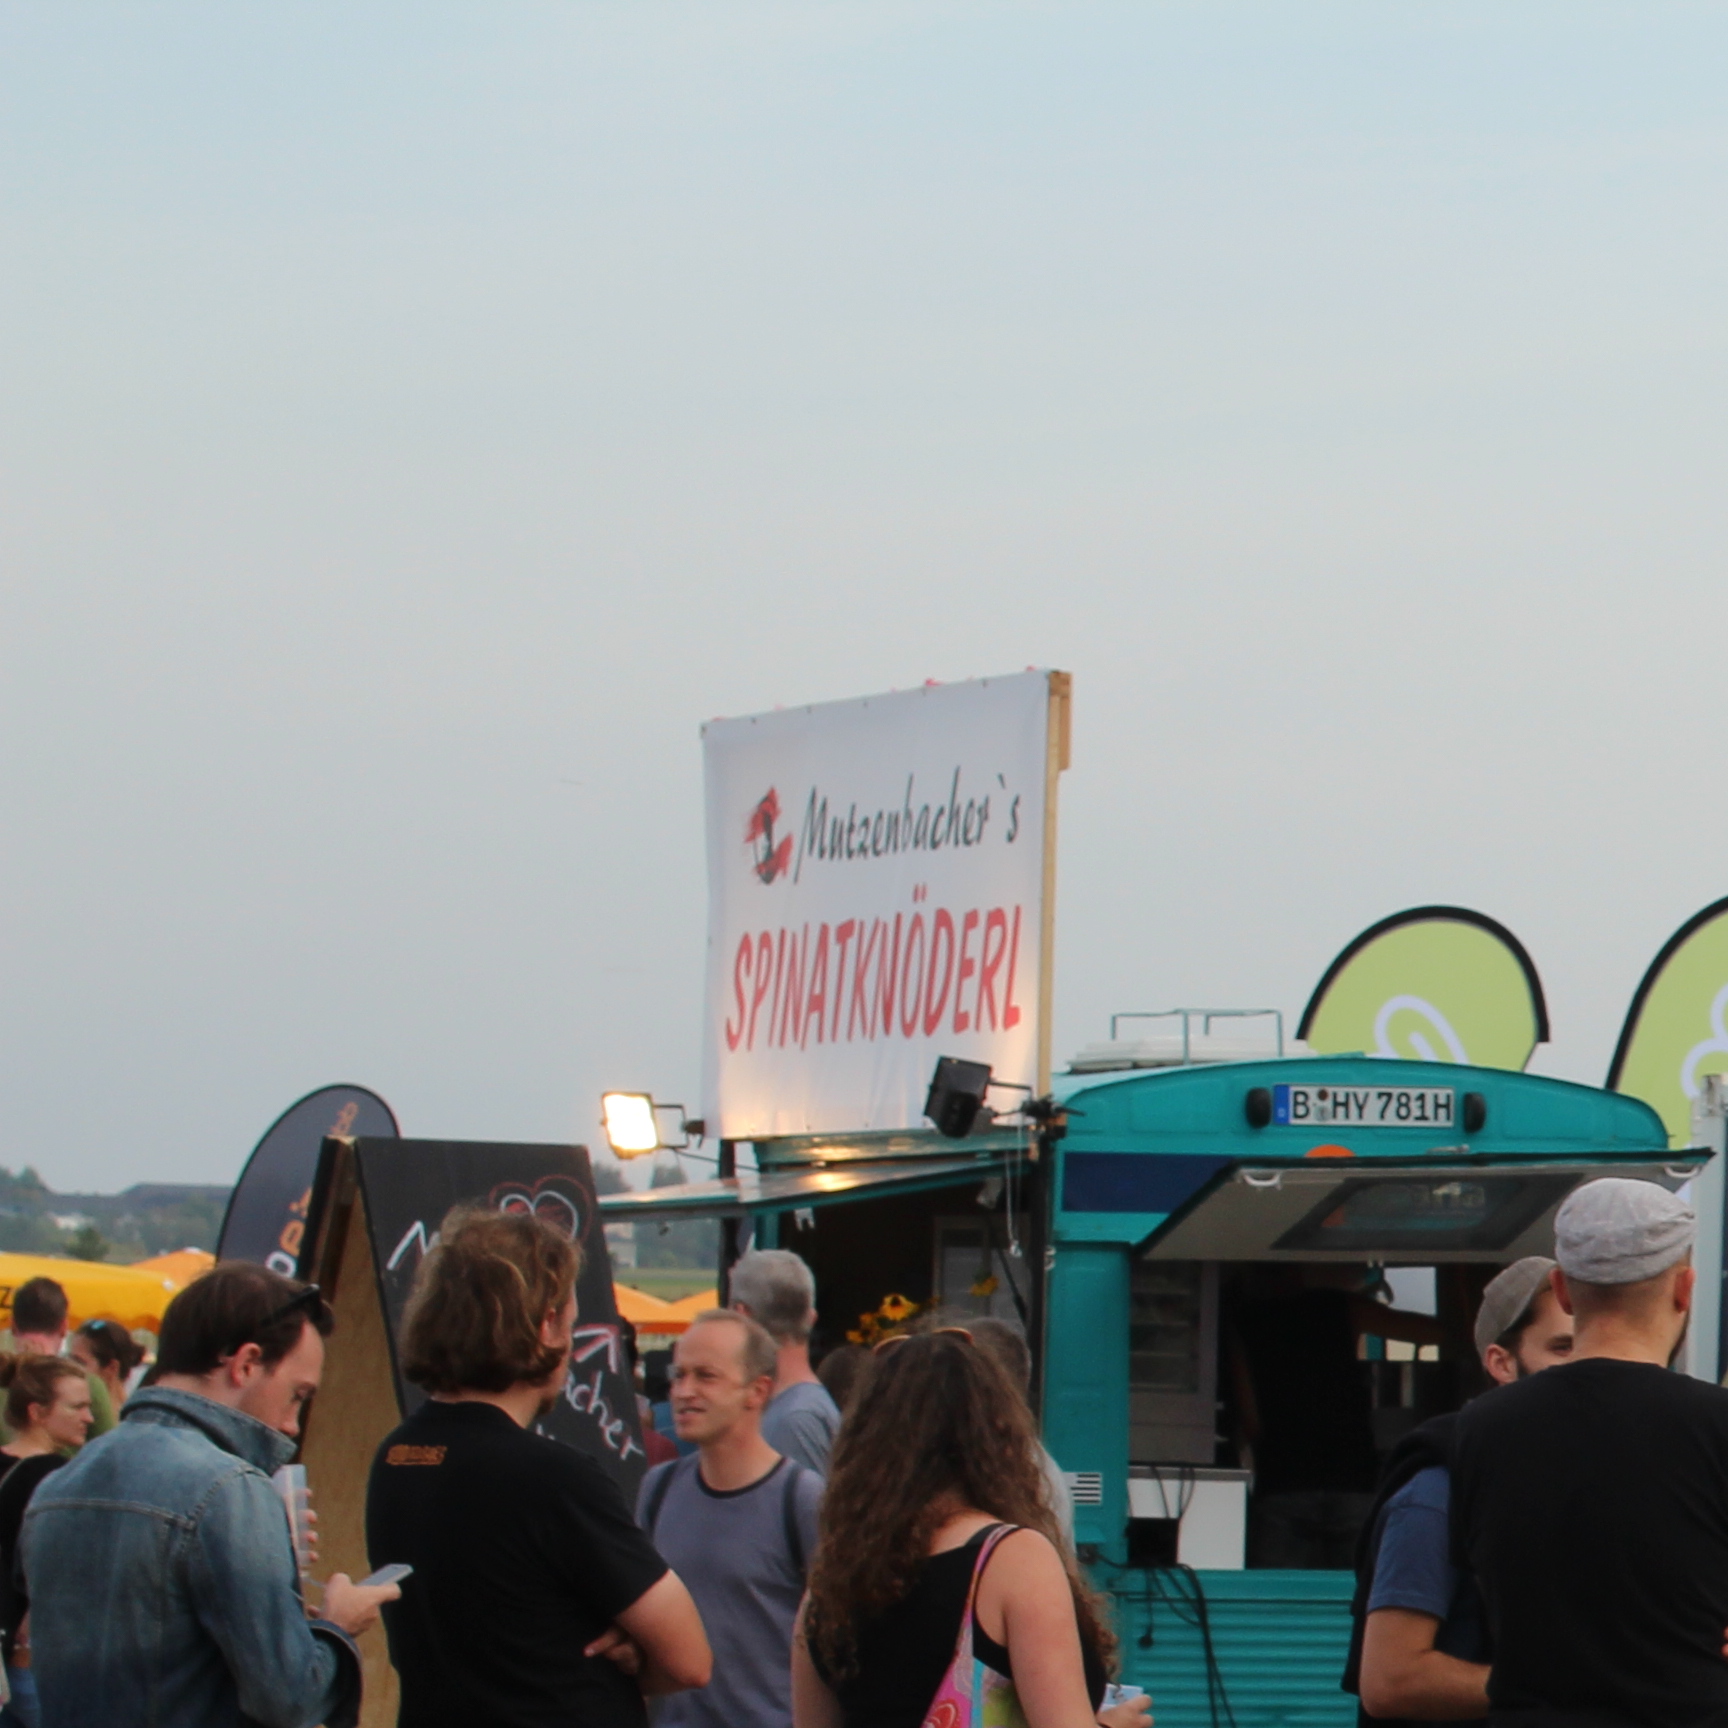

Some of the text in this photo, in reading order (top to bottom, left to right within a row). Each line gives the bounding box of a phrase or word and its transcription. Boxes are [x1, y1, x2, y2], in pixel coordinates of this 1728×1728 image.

[726, 884, 1024, 1053] SPINATKNÖDERL
[1293, 1091, 1452, 1122] B HY 781H
